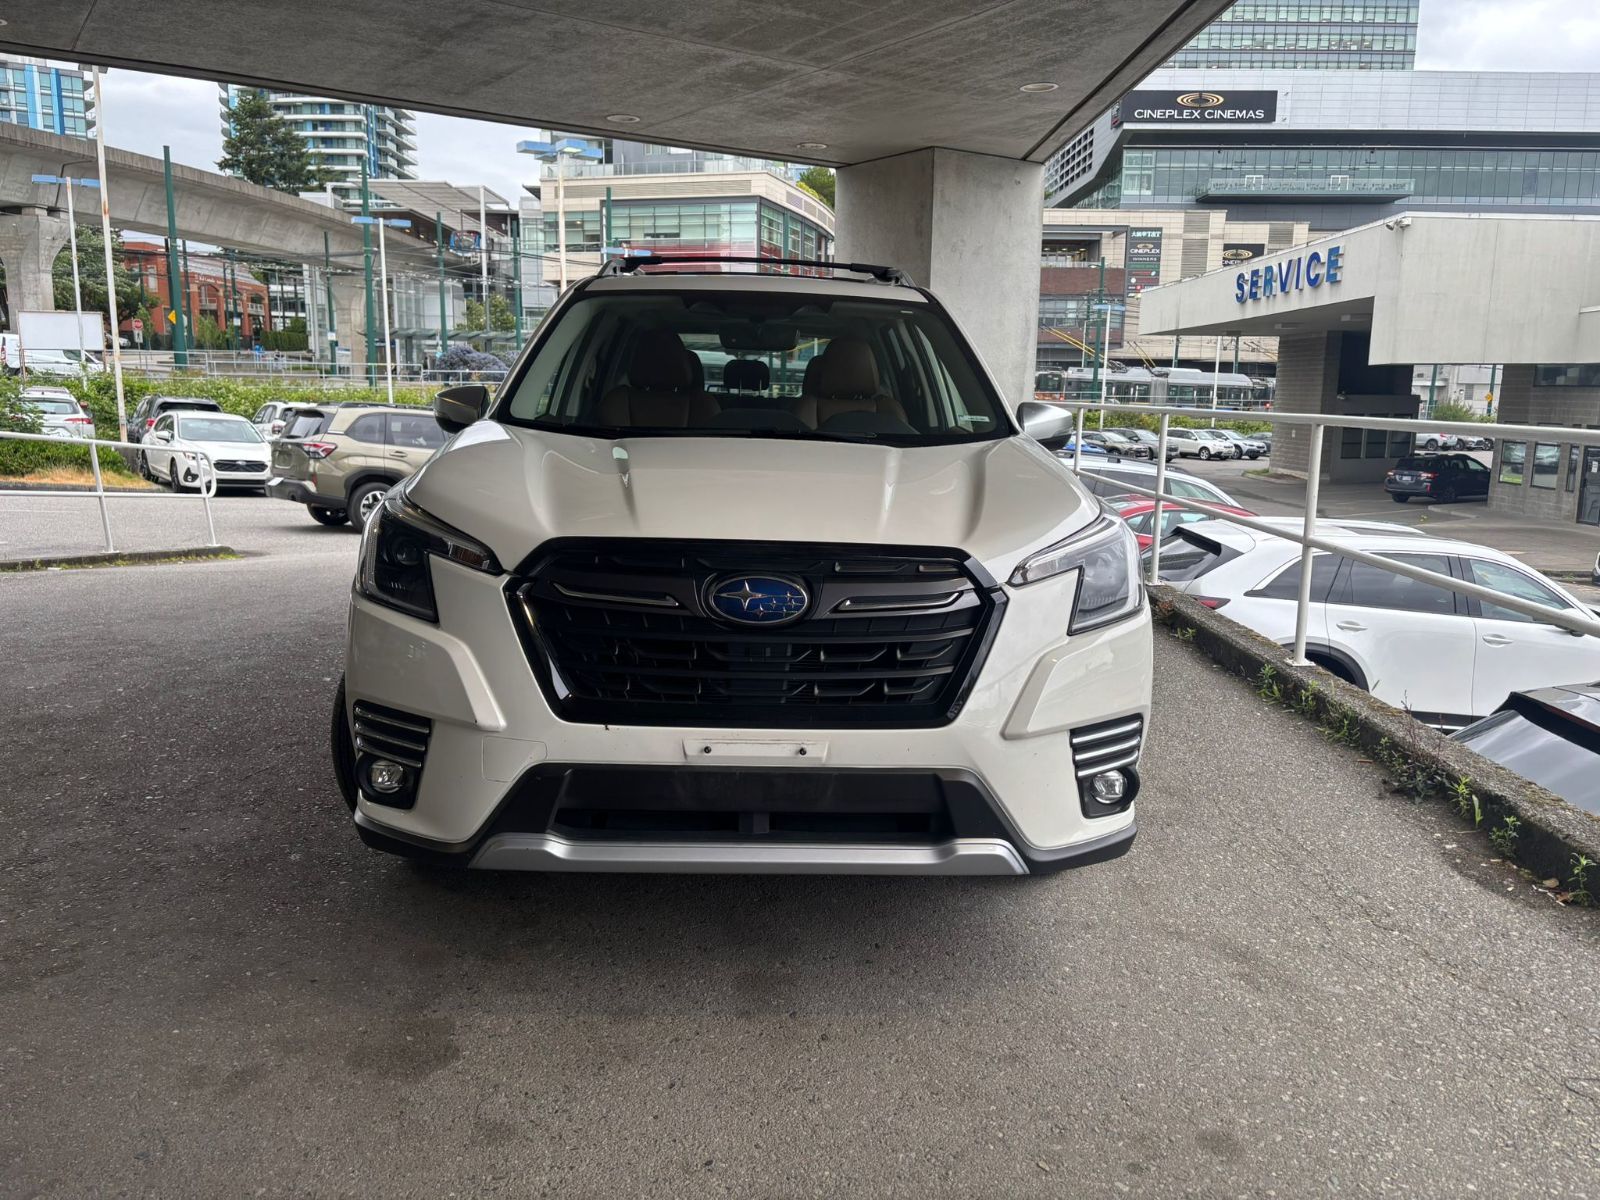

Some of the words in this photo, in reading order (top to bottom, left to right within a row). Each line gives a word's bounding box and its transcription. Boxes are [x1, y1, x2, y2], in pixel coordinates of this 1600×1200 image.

[1134, 109, 1201, 119] CINEPLEX
[1204, 109, 1265, 119] CINEMAS
[1235, 245, 1344, 304] SERVICE
